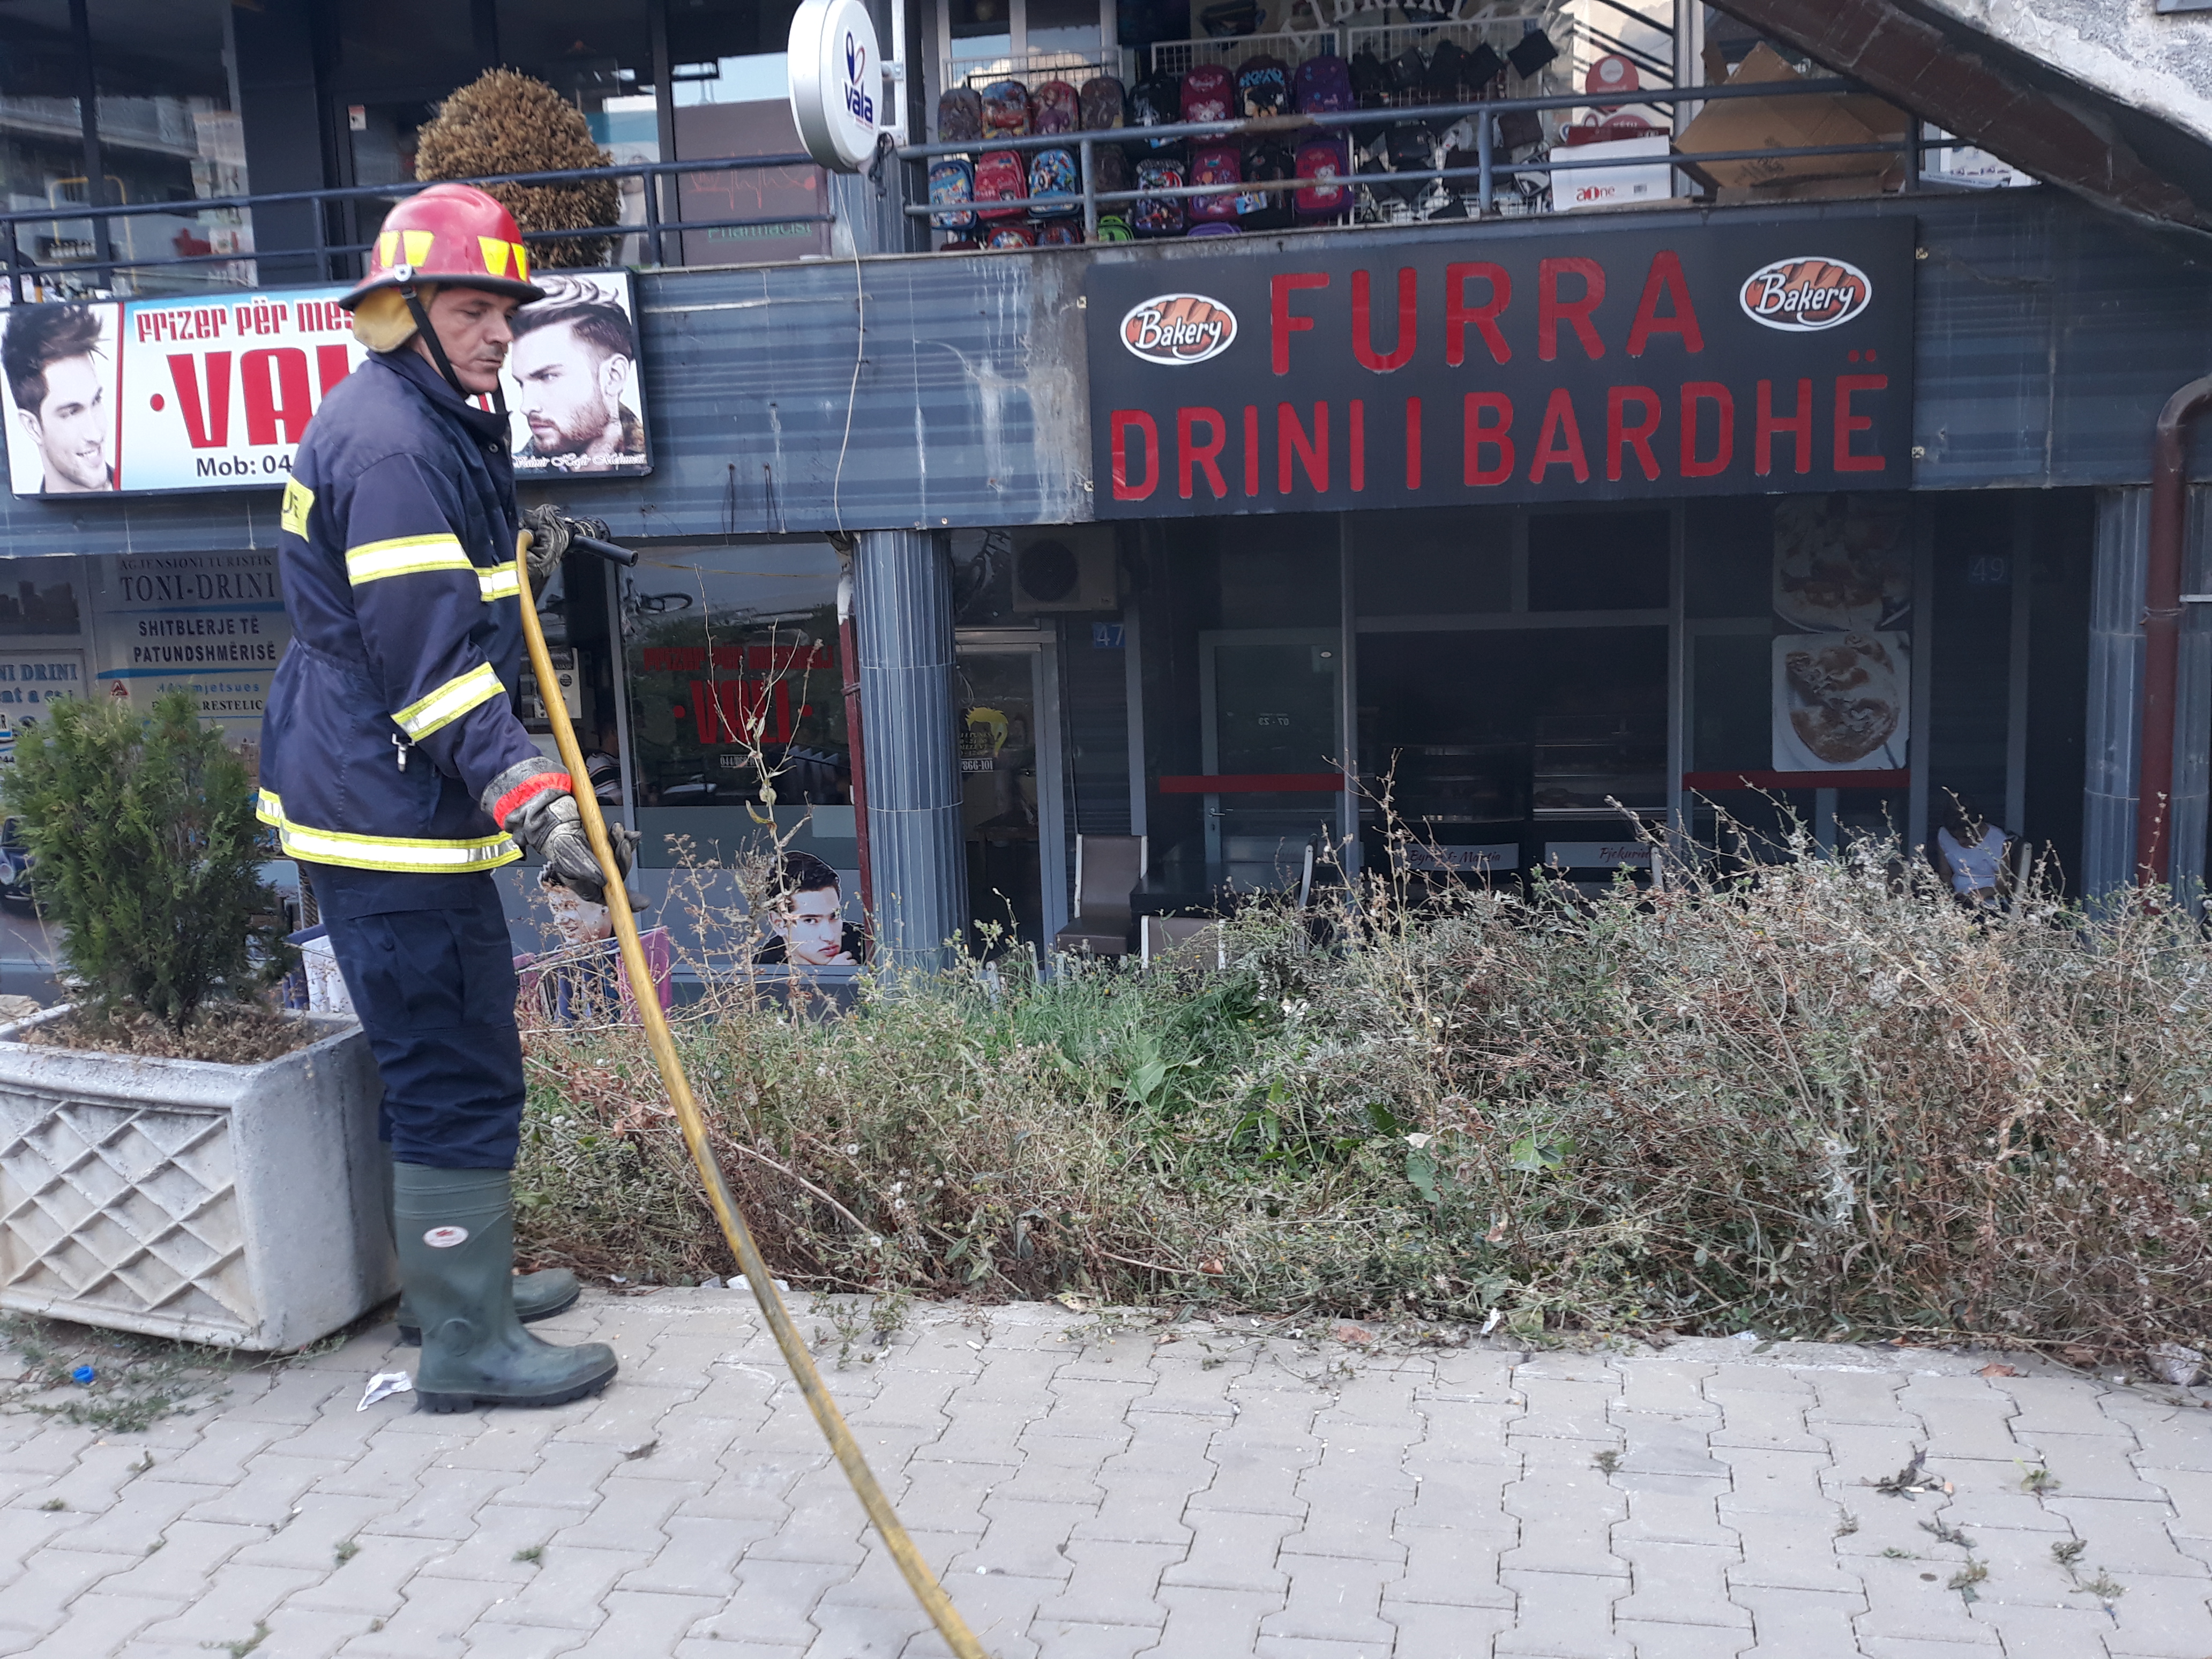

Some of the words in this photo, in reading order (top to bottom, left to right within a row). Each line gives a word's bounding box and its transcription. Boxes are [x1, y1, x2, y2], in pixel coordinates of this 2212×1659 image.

[844, 80, 873, 123] vala
[1271, 250, 1705, 376] FURRA
[1755, 272, 1855, 327] Bakery
[136, 308, 228, 343] Frizer
[236, 300, 288, 336] për
[1135, 308, 1223, 360] Bakery
[1110, 399, 1365, 501] DRINI
[1406, 397, 1422, 490] I
[1463, 349, 1888, 486] BARDHË
[197, 455, 256, 477] Mob:
[1972, 557, 2005, 581] 49
[120, 572, 275, 602] TONI-DRINI
[138, 618, 236, 638] SHITBLERJE
[240, 615, 260, 635] TË
[1096, 622, 1125, 646] 47
[133, 640, 276, 663] PATUNDSHMËRISË
[20, 663, 78, 681] DRINI
[961, 759, 993, 771] 866-101
